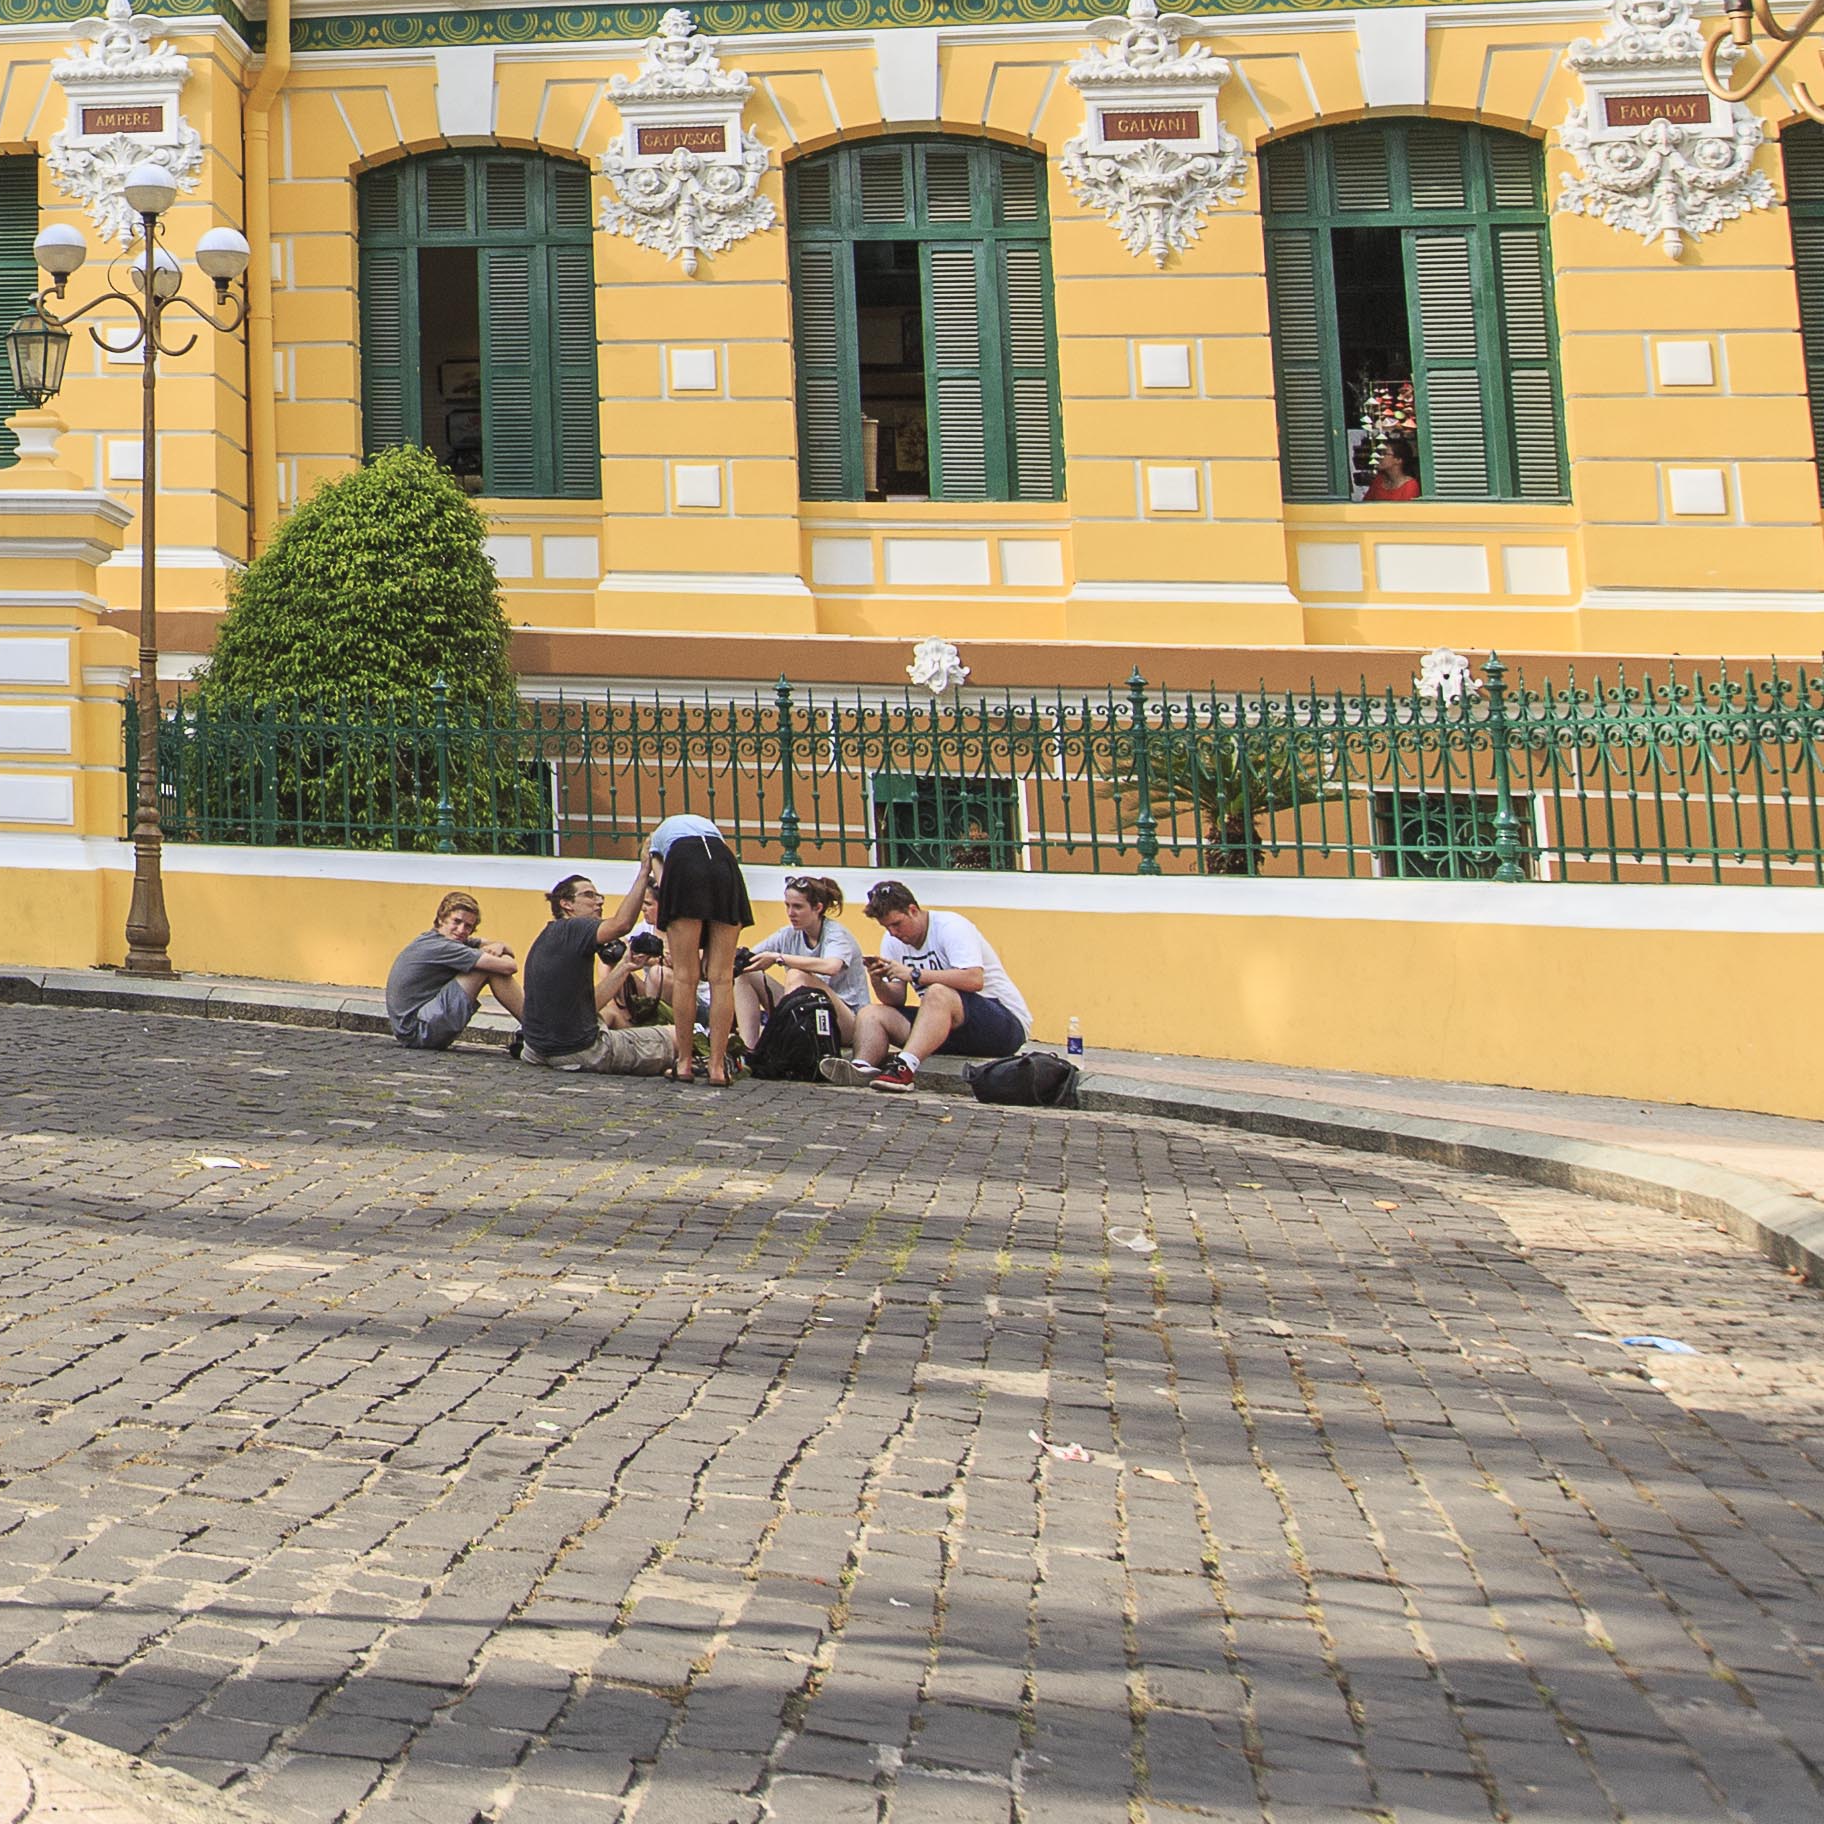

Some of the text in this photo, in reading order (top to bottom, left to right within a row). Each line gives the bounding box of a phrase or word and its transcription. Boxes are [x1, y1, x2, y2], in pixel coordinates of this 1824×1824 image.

[1619, 102, 1697, 119] FARADAY
[95, 112, 151, 127] AMPERE
[1117, 117, 1187, 132] GALVANI
